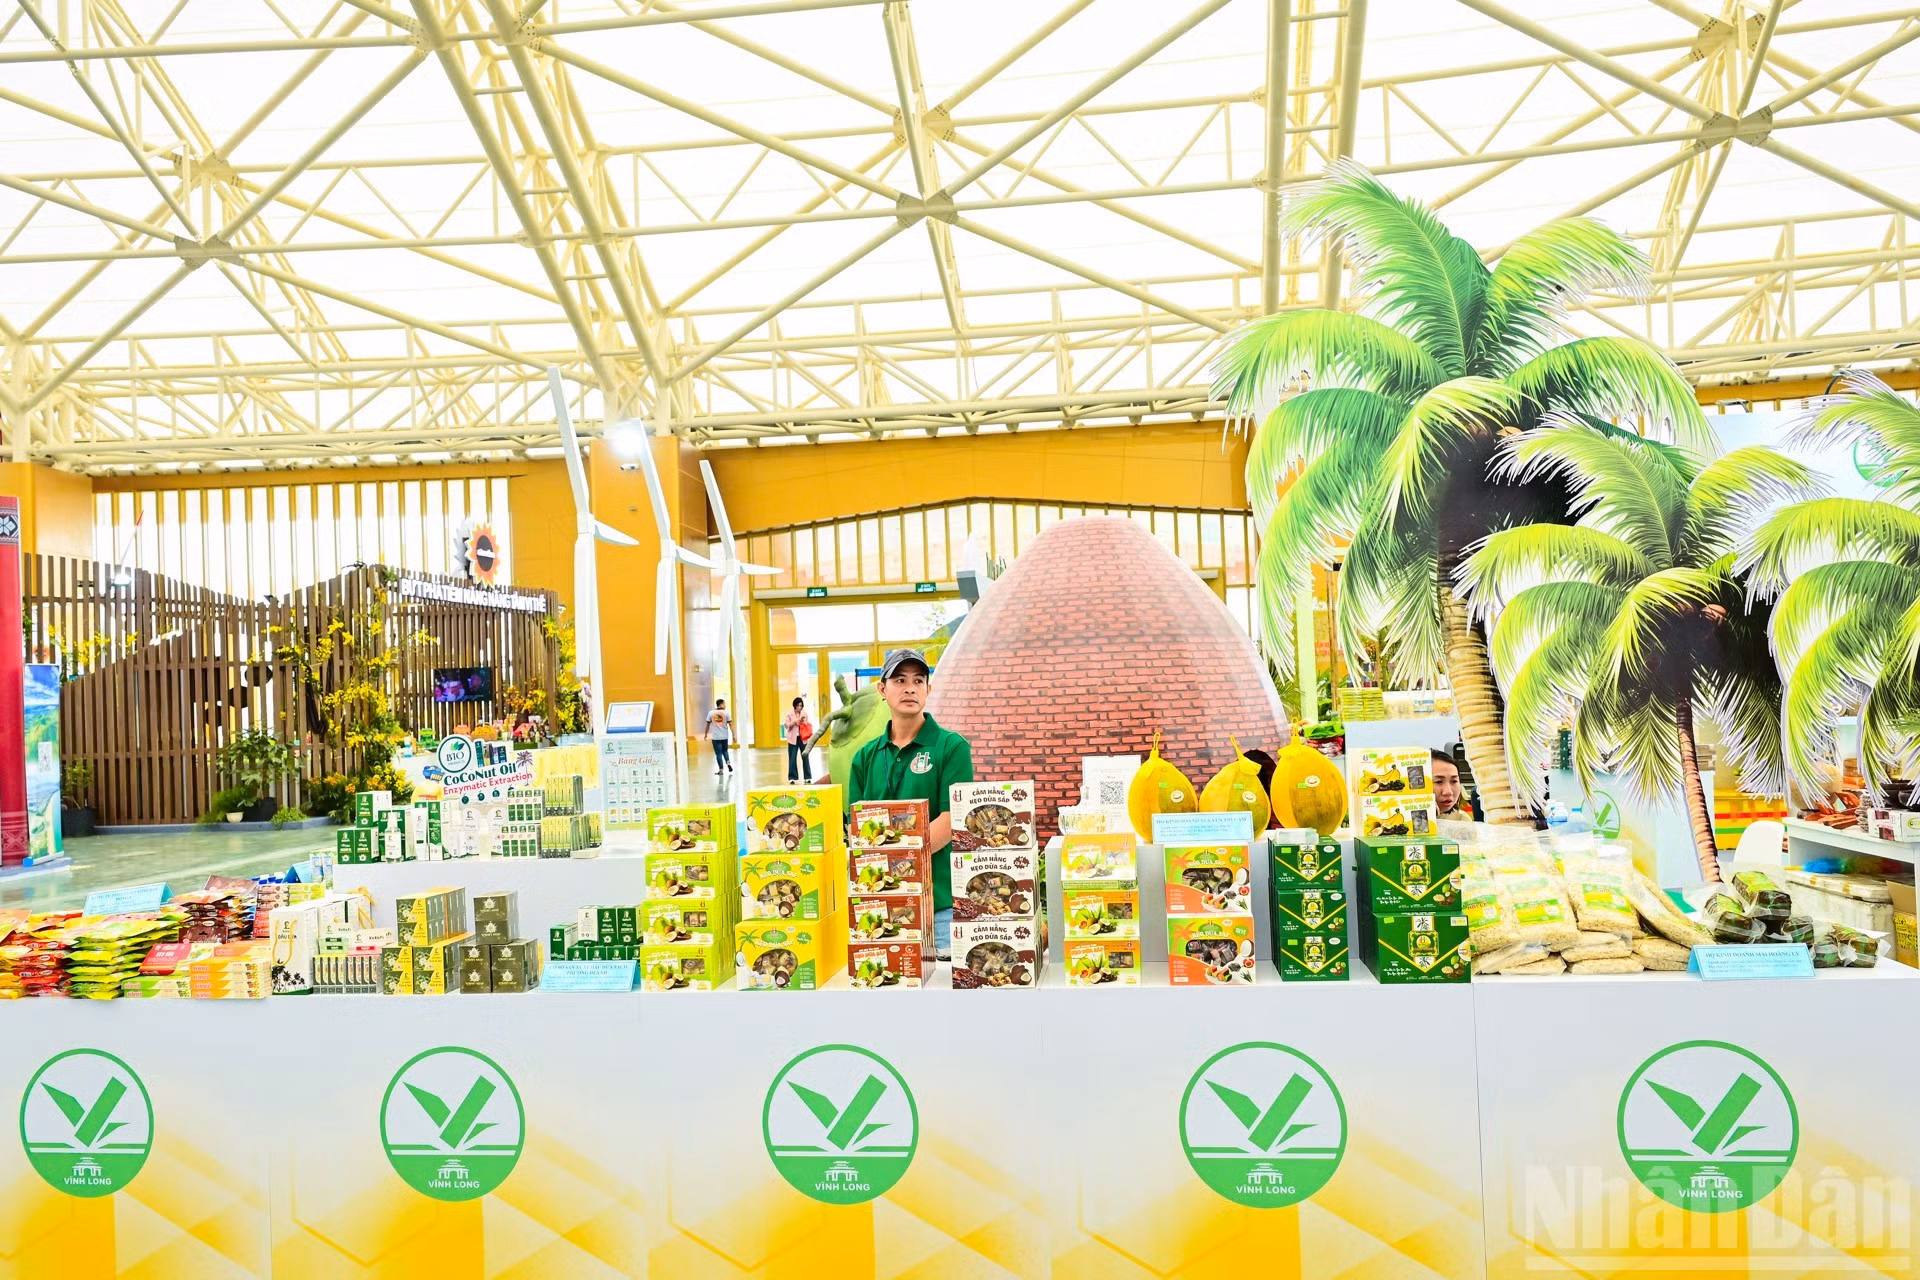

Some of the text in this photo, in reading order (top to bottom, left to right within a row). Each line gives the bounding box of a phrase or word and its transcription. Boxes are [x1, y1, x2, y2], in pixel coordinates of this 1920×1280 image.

[446, 751, 465, 762] BIO
[444, 762, 517, 786] CoCoNut Oil
[443, 772, 533, 795] Enzymatic Extraction
[843, 1183, 870, 1191] LONG
[1266, 1186, 1296, 1194] LONG
[1711, 1190, 1743, 1198] LONG
